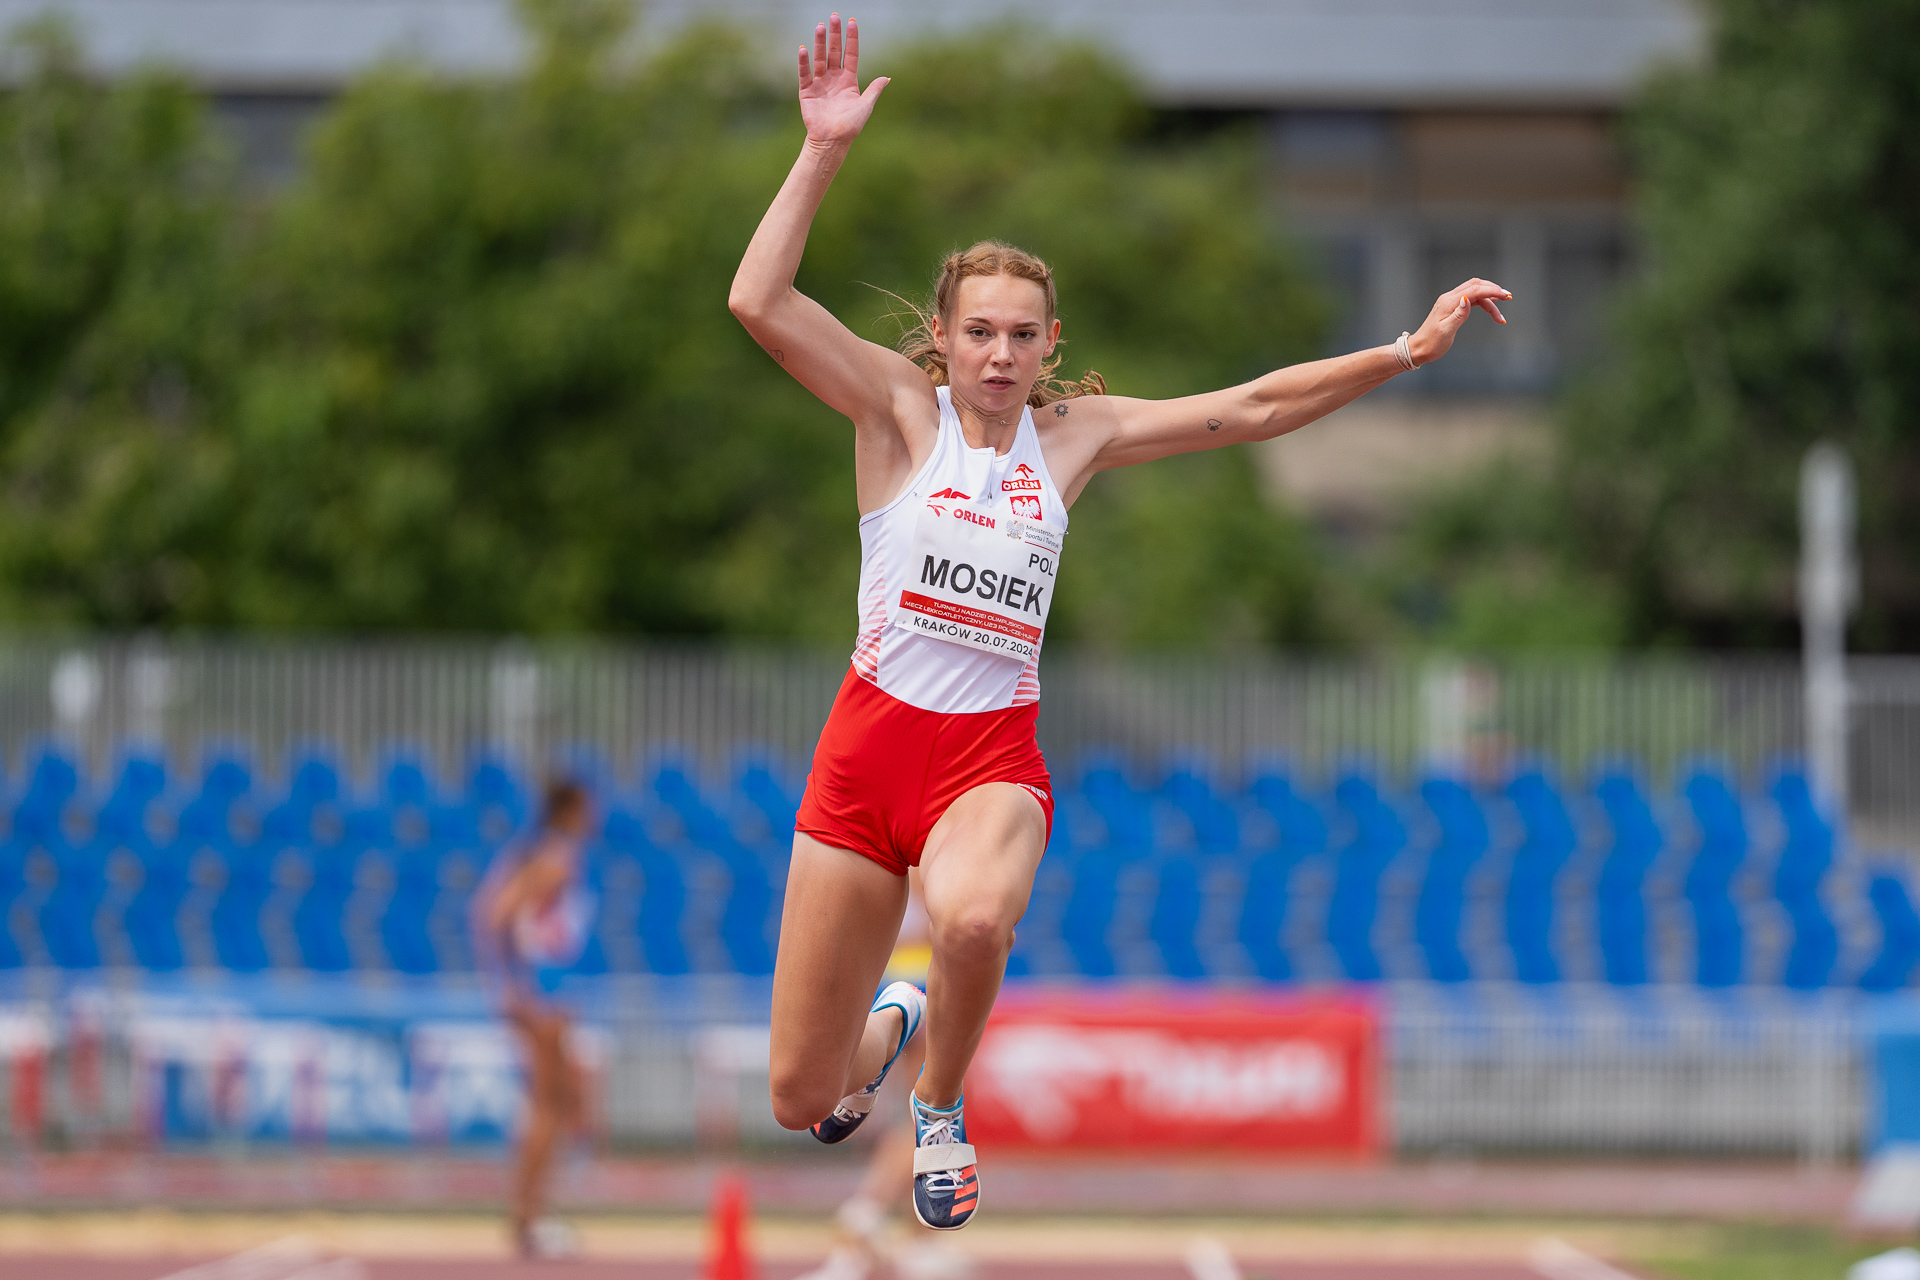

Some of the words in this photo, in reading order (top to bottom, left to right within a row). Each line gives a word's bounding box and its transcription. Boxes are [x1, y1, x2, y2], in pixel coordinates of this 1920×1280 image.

[1003, 480, 1039, 490] ORLEN
[953, 508, 996, 529] ORLEN
[1025, 532, 1043, 542] Sportu
[1028, 553, 1053, 577] POL
[920, 554, 1044, 617] MOSIEK
[904, 601, 923, 610] MECZ
[934, 601, 961, 613] TURNIEJ
[961, 608, 987, 619] NADZIEI
[987, 615, 1025, 630] OLIMPIJSKICH
[914, 616, 971, 639] KRAKÓW
[973, 632, 1033, 657] 20.07.2024
